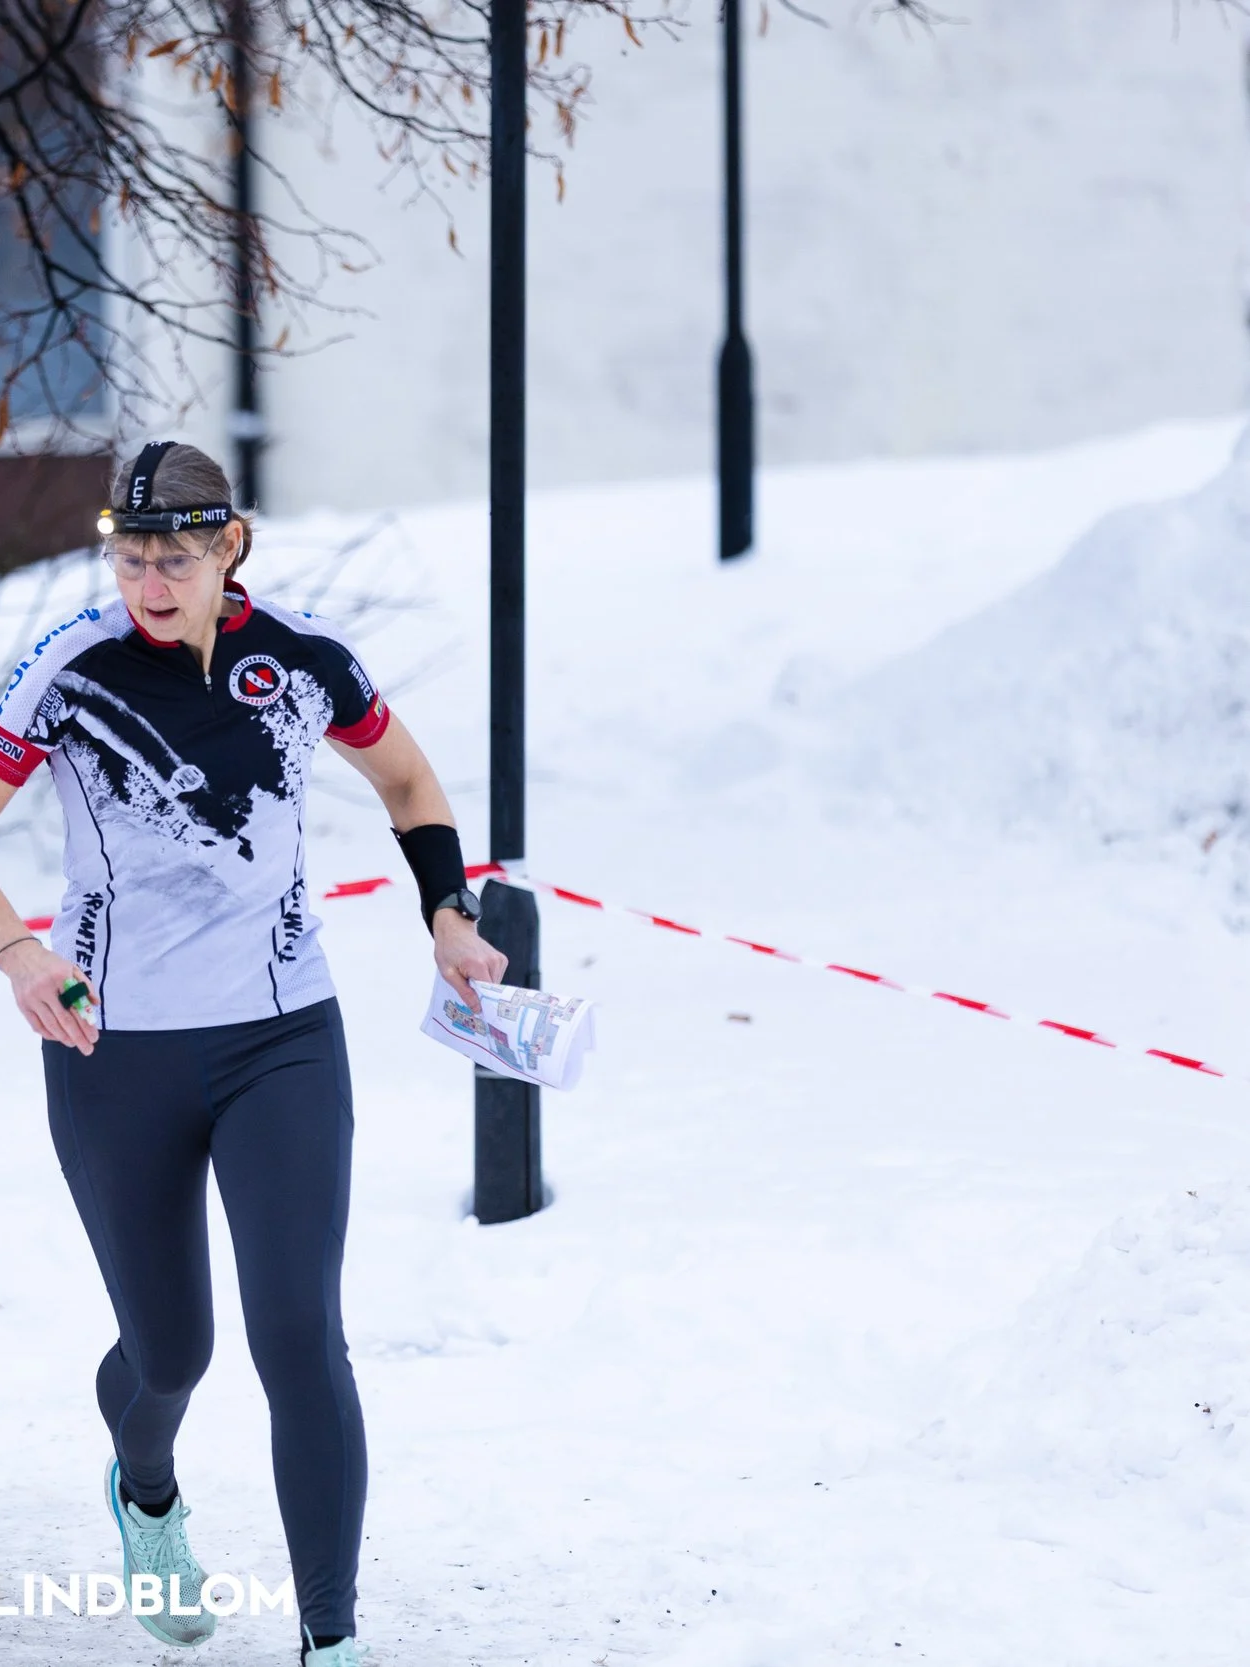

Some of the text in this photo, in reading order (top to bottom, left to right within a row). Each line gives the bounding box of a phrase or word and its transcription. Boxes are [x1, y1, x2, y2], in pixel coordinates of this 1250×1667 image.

[178, 509, 227, 524] MONITE
[348, 660, 373, 702] TRIMTEX
[39, 686, 59, 717] INTER
[46, 692, 65, 723] SPORT
